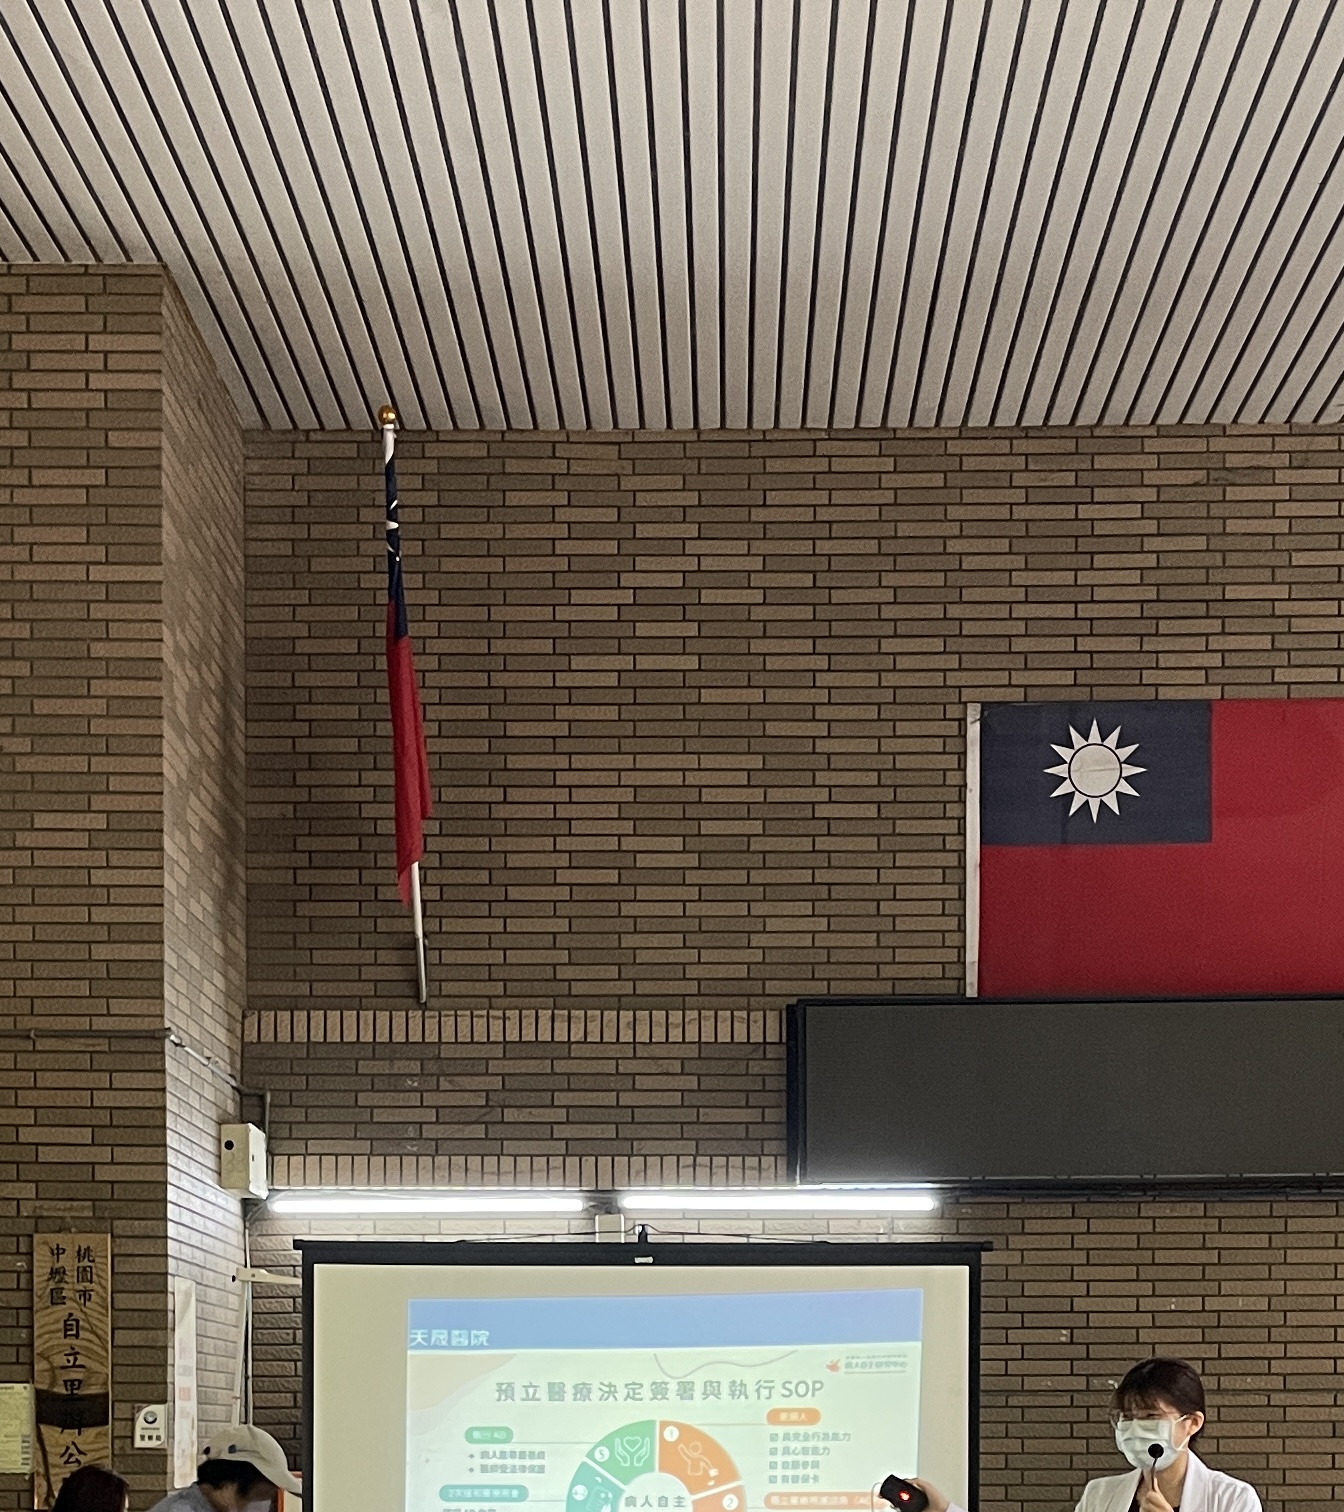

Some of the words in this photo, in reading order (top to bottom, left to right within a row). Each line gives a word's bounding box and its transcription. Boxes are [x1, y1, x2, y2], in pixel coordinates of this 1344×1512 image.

[47, 1243, 68, 1306] 中壢區
[76, 1245, 95, 1308] 桃園市
[409, 1328, 491, 1348] 天晟醫院
[624, 1495, 686, 1508] 病人自主
